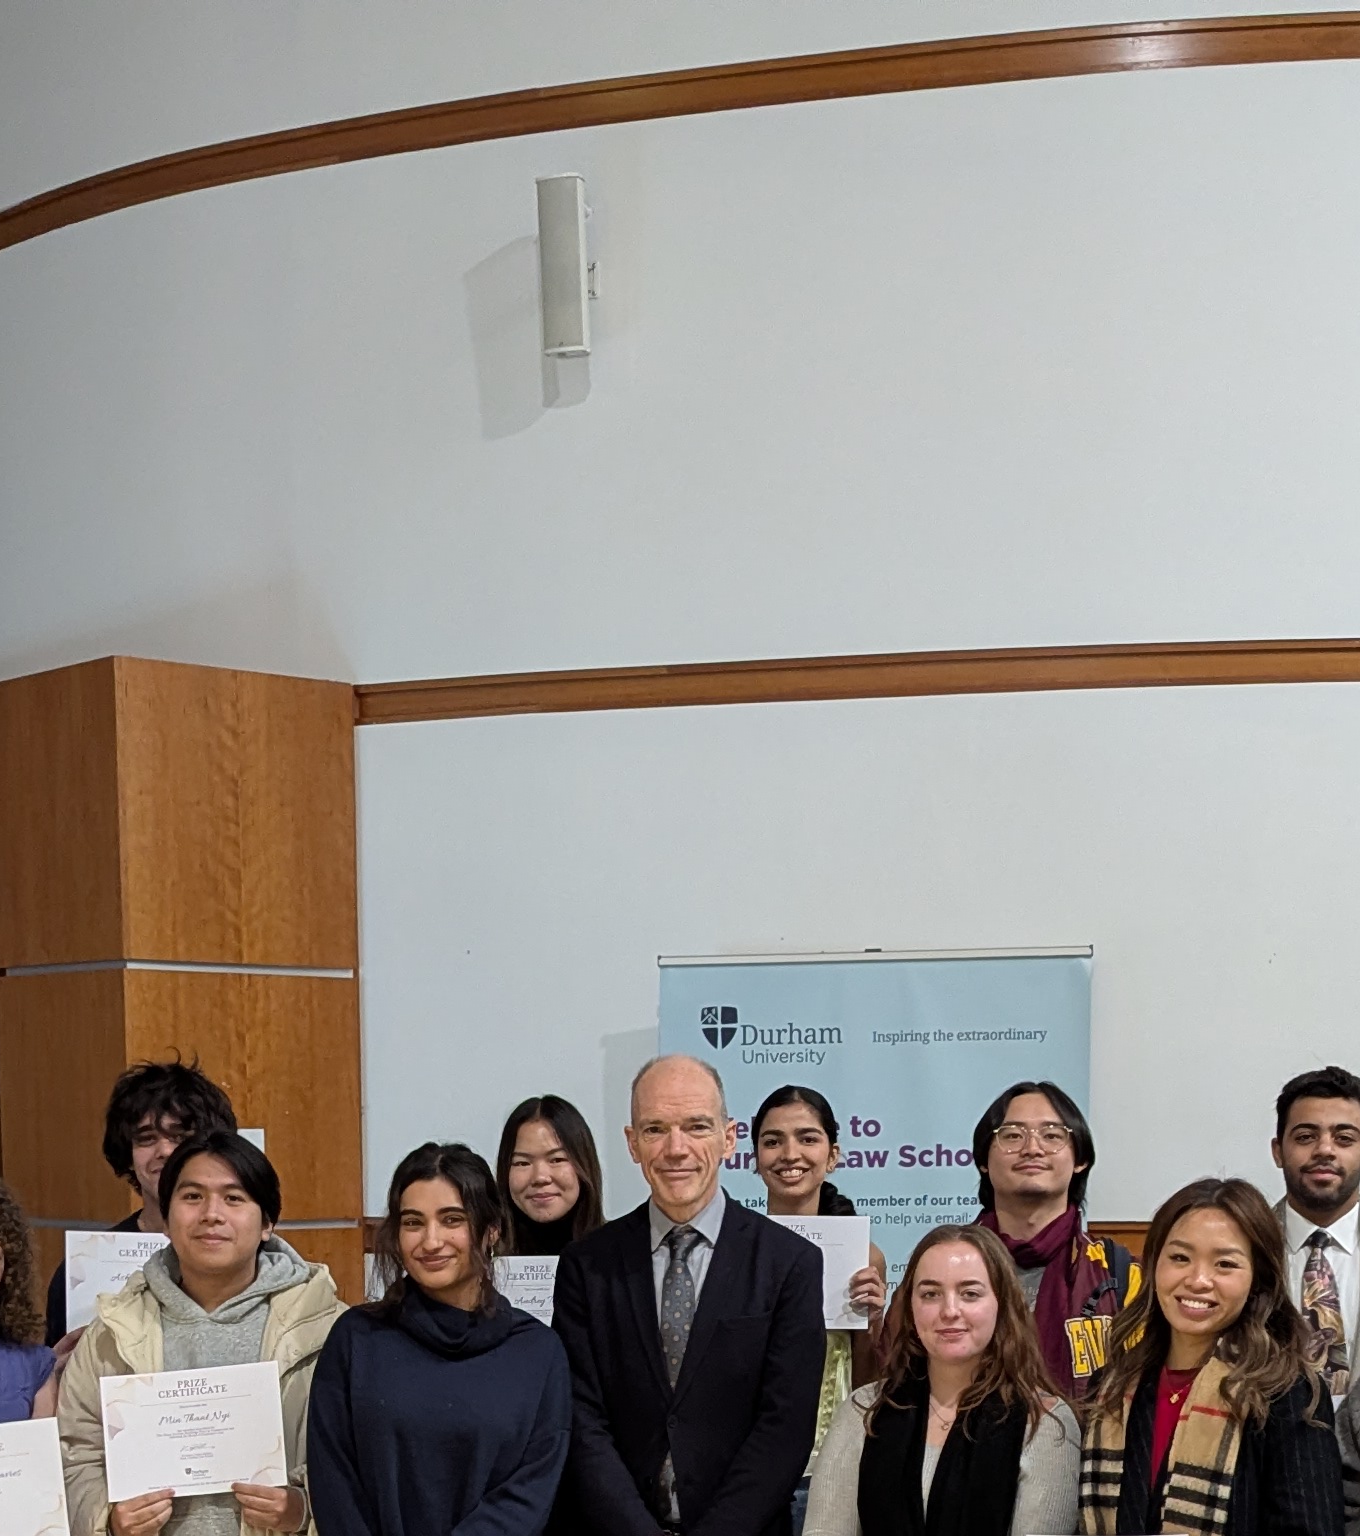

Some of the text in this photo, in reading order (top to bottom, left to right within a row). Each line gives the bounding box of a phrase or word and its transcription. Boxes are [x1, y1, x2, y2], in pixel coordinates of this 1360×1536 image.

[740, 1022, 843, 1046] Durham
[872, 1028, 1048, 1045] Inspiring the extraordinary
[742, 1049, 826, 1065] University
[850, 1116, 881, 1137] to
[898, 1144, 974, 1168] Scho
[745, 1197, 766, 1208] tak
[857, 1195, 981, 1206] member of our tea
[885, 1214, 911, 1226] help
[914, 1214, 932, 1224] via
[935, 1213, 972, 1224] email:
[524, 1265, 551, 1273] PRIZE
[507, 1273, 556, 1281] CERTIFICA
[177, 1378, 208, 1388] PRIZE
[158, 1384, 228, 1399] CERTIFICATE
